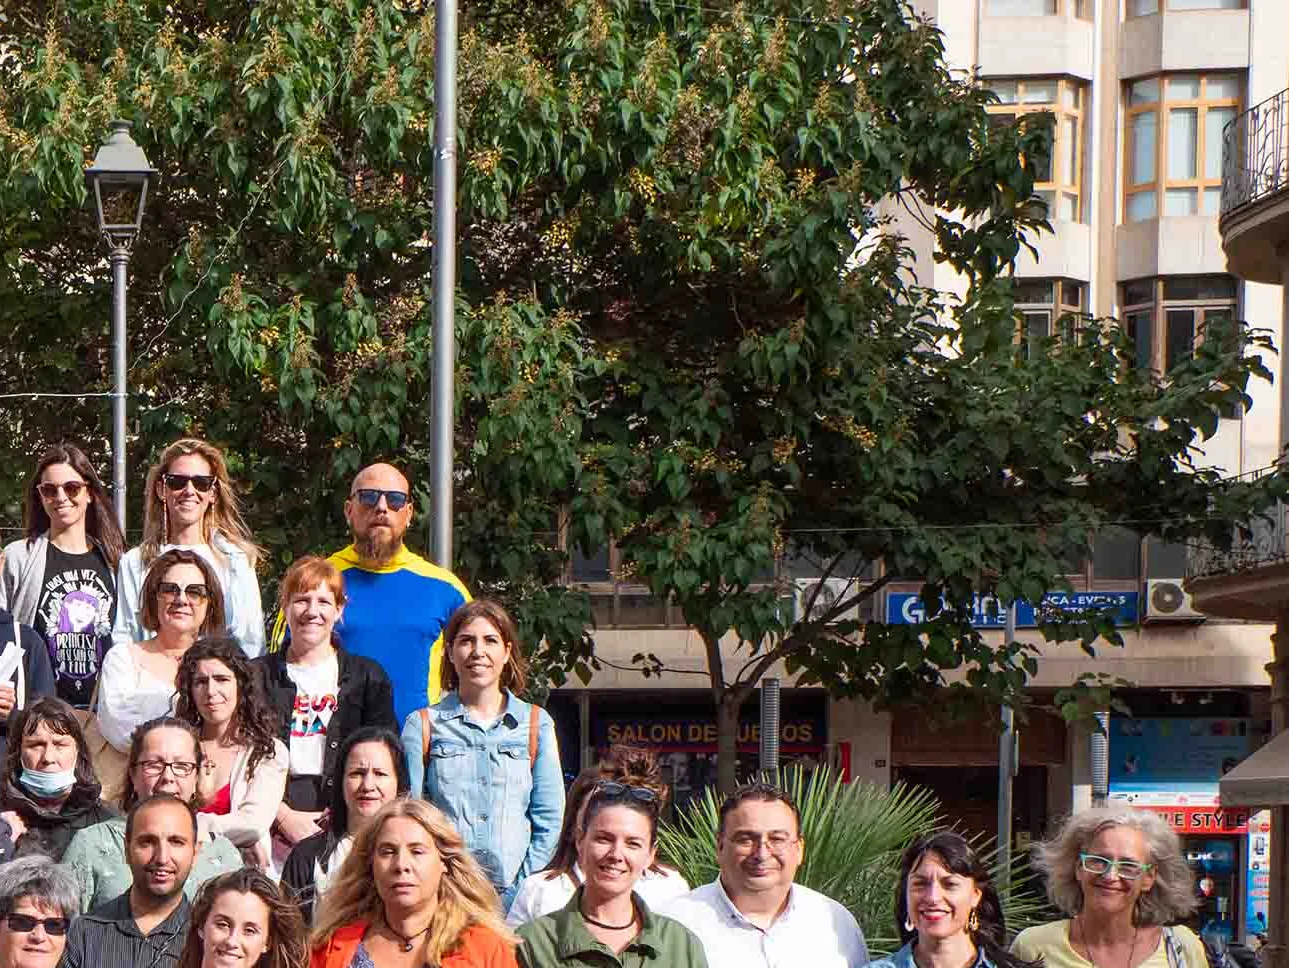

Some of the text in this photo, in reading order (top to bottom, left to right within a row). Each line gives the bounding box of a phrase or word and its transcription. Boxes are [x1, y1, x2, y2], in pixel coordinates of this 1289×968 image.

[81, 569, 97, 581] VEZ
[607, 724, 814, 743] SALON DE UEOS
[1191, 813, 1247, 827] STYLE
